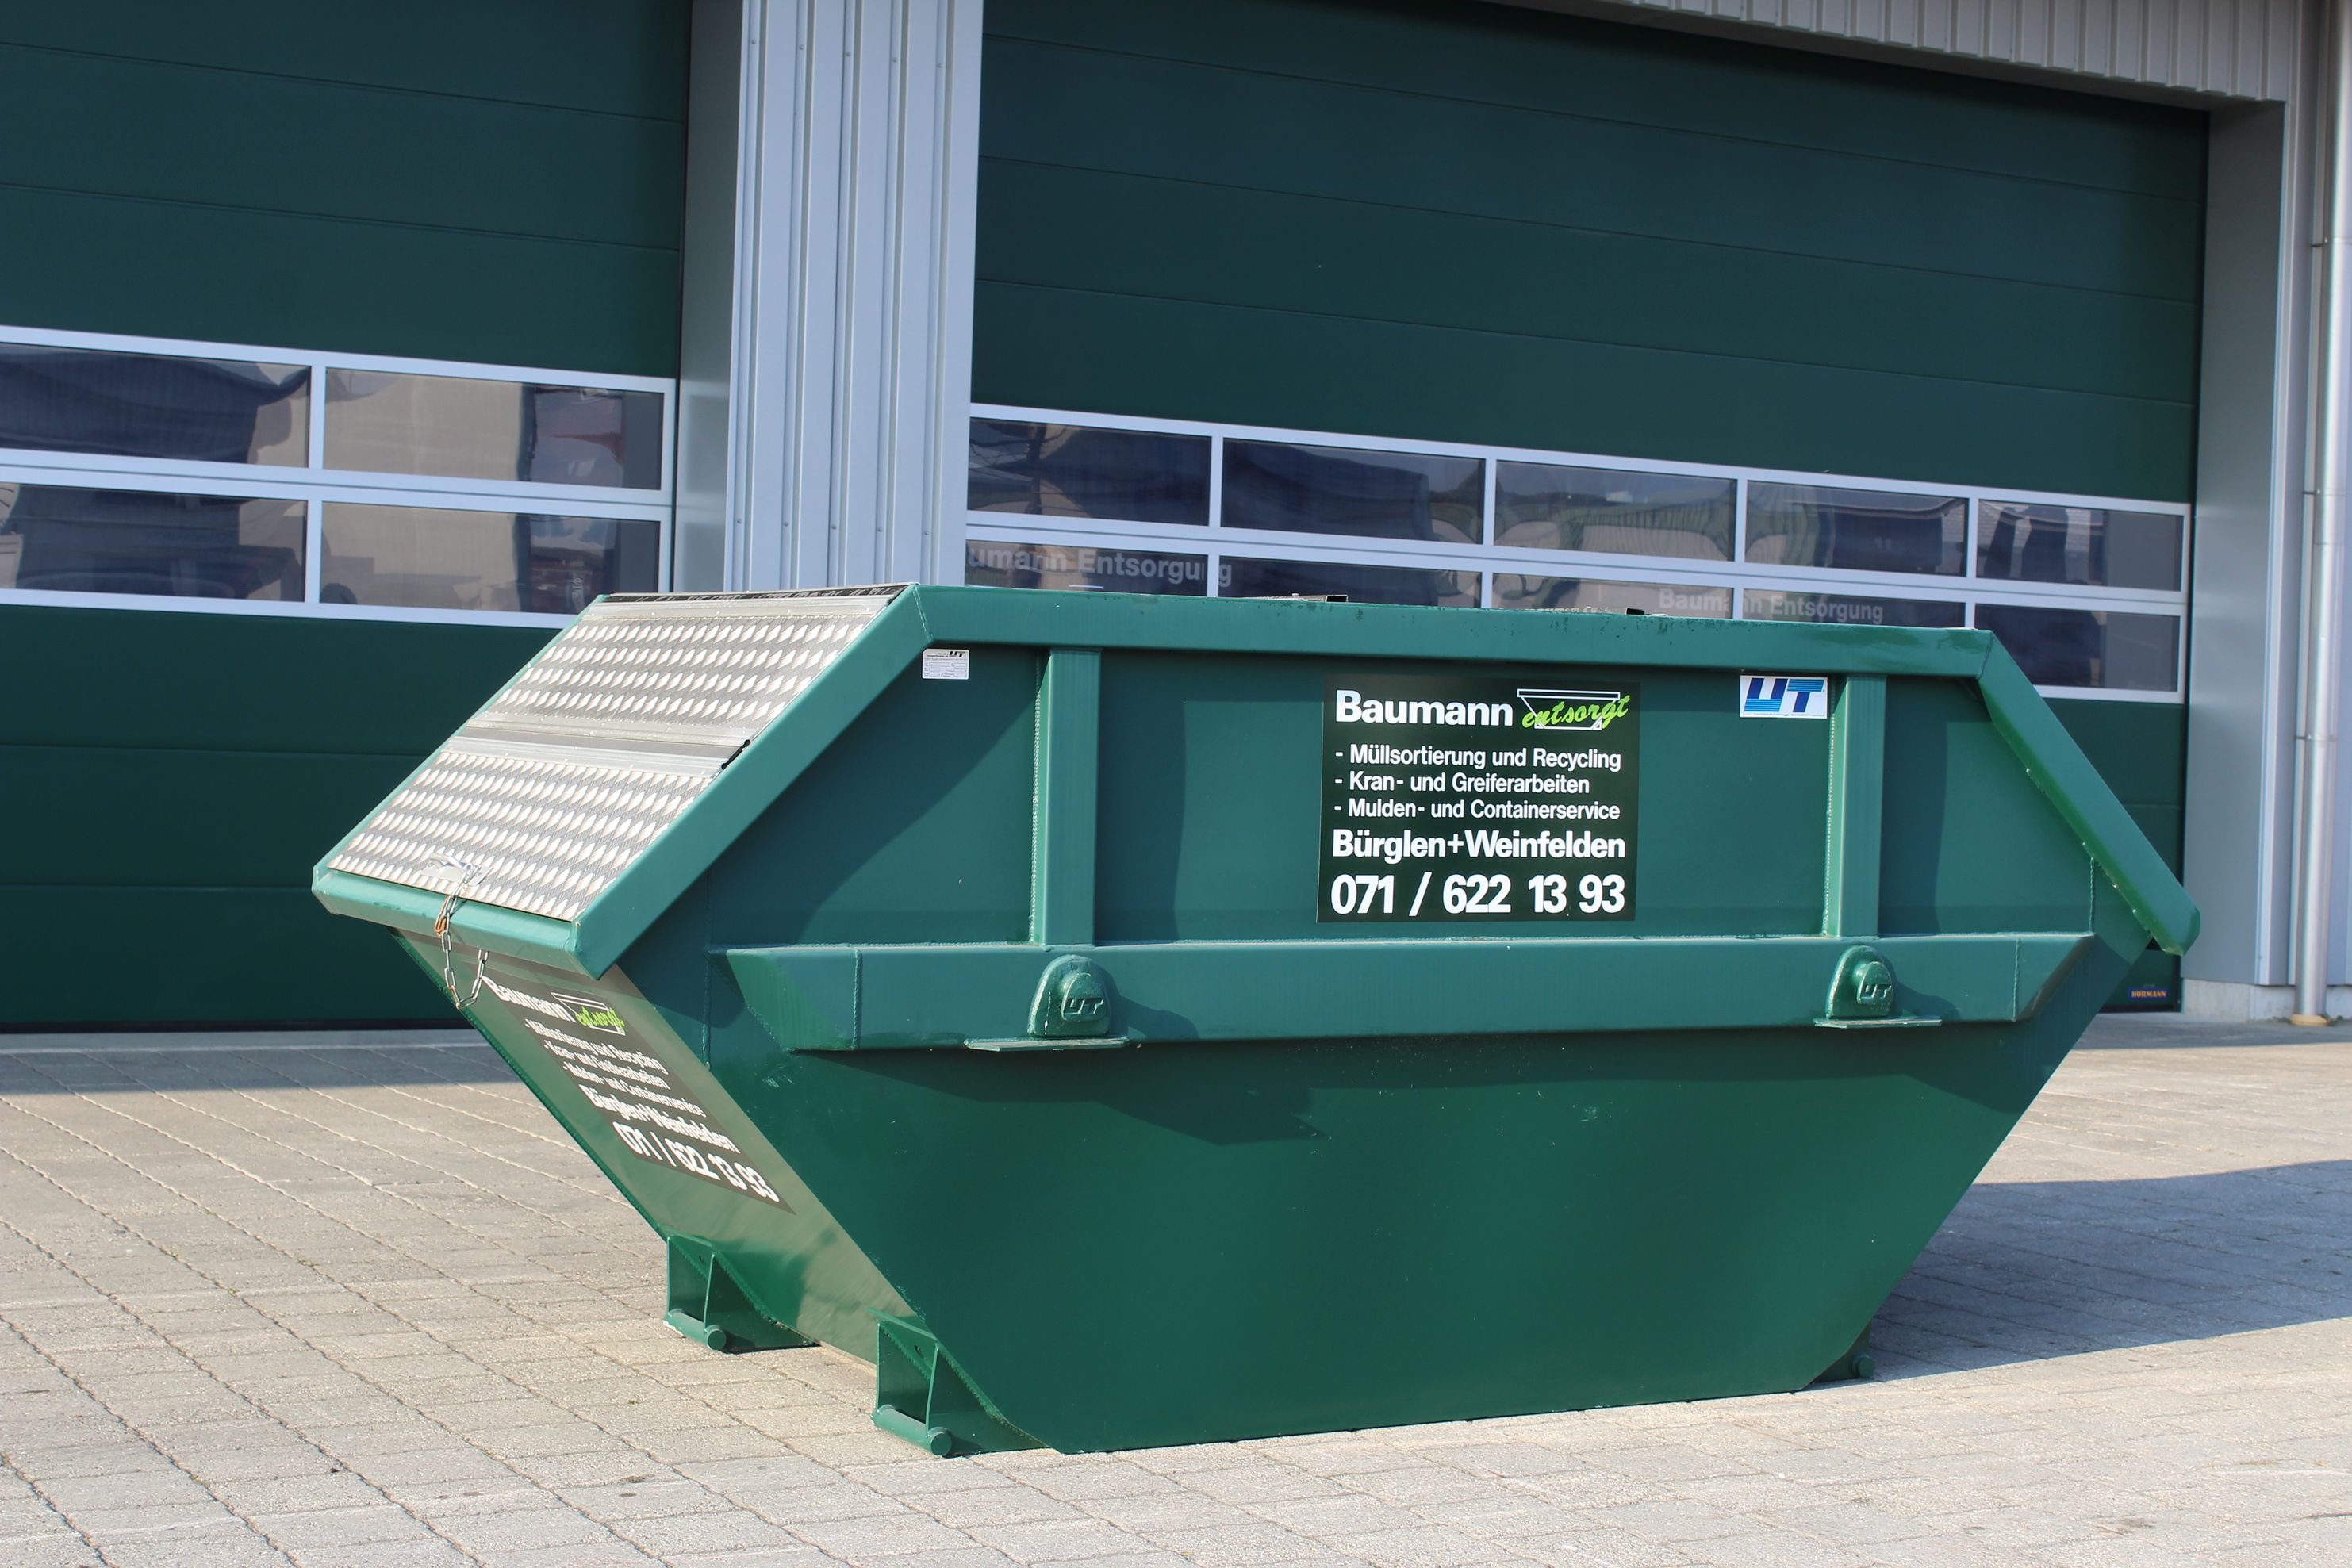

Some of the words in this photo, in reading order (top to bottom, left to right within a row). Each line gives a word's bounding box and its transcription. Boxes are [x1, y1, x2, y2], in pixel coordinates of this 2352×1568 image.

[1079, 549, 1232, 587] Entsorgug
[1771, 596, 1884, 625] Entsorgung
[1336, 689, 1514, 726] Baumann
[1521, 695, 1631, 729] entsorgt
[1744, 677, 1825, 713] UT
[1350, 743, 1486, 770] Müllsortierung
[1492, 747, 1527, 767] und
[1533, 747, 1621, 772] Recycling
[1349, 770, 1404, 791] Kran-
[1410, 772, 1446, 792] und
[1452, 772, 1590, 794] Greiferarbeiten
[1349, 798, 1425, 818] Mulden-
[1431, 799, 1464, 819] und
[1470, 799, 1621, 820] Containerservice
[1333, 829, 1626, 865] Bürglen+Weinfelden
[1330, 874, 1395, 914] 071
[1408, 871, 1433, 917] /
[1443, 874, 1511, 914] 622
[1528, 874, 1567, 914] 13
[1579, 874, 1625, 914] 93
[482, 976, 577, 1023] Baumann
[612, 1121, 663, 1161] 071
[707, 1152, 748, 1190] 13
[733, 1161, 780, 1202] 93
